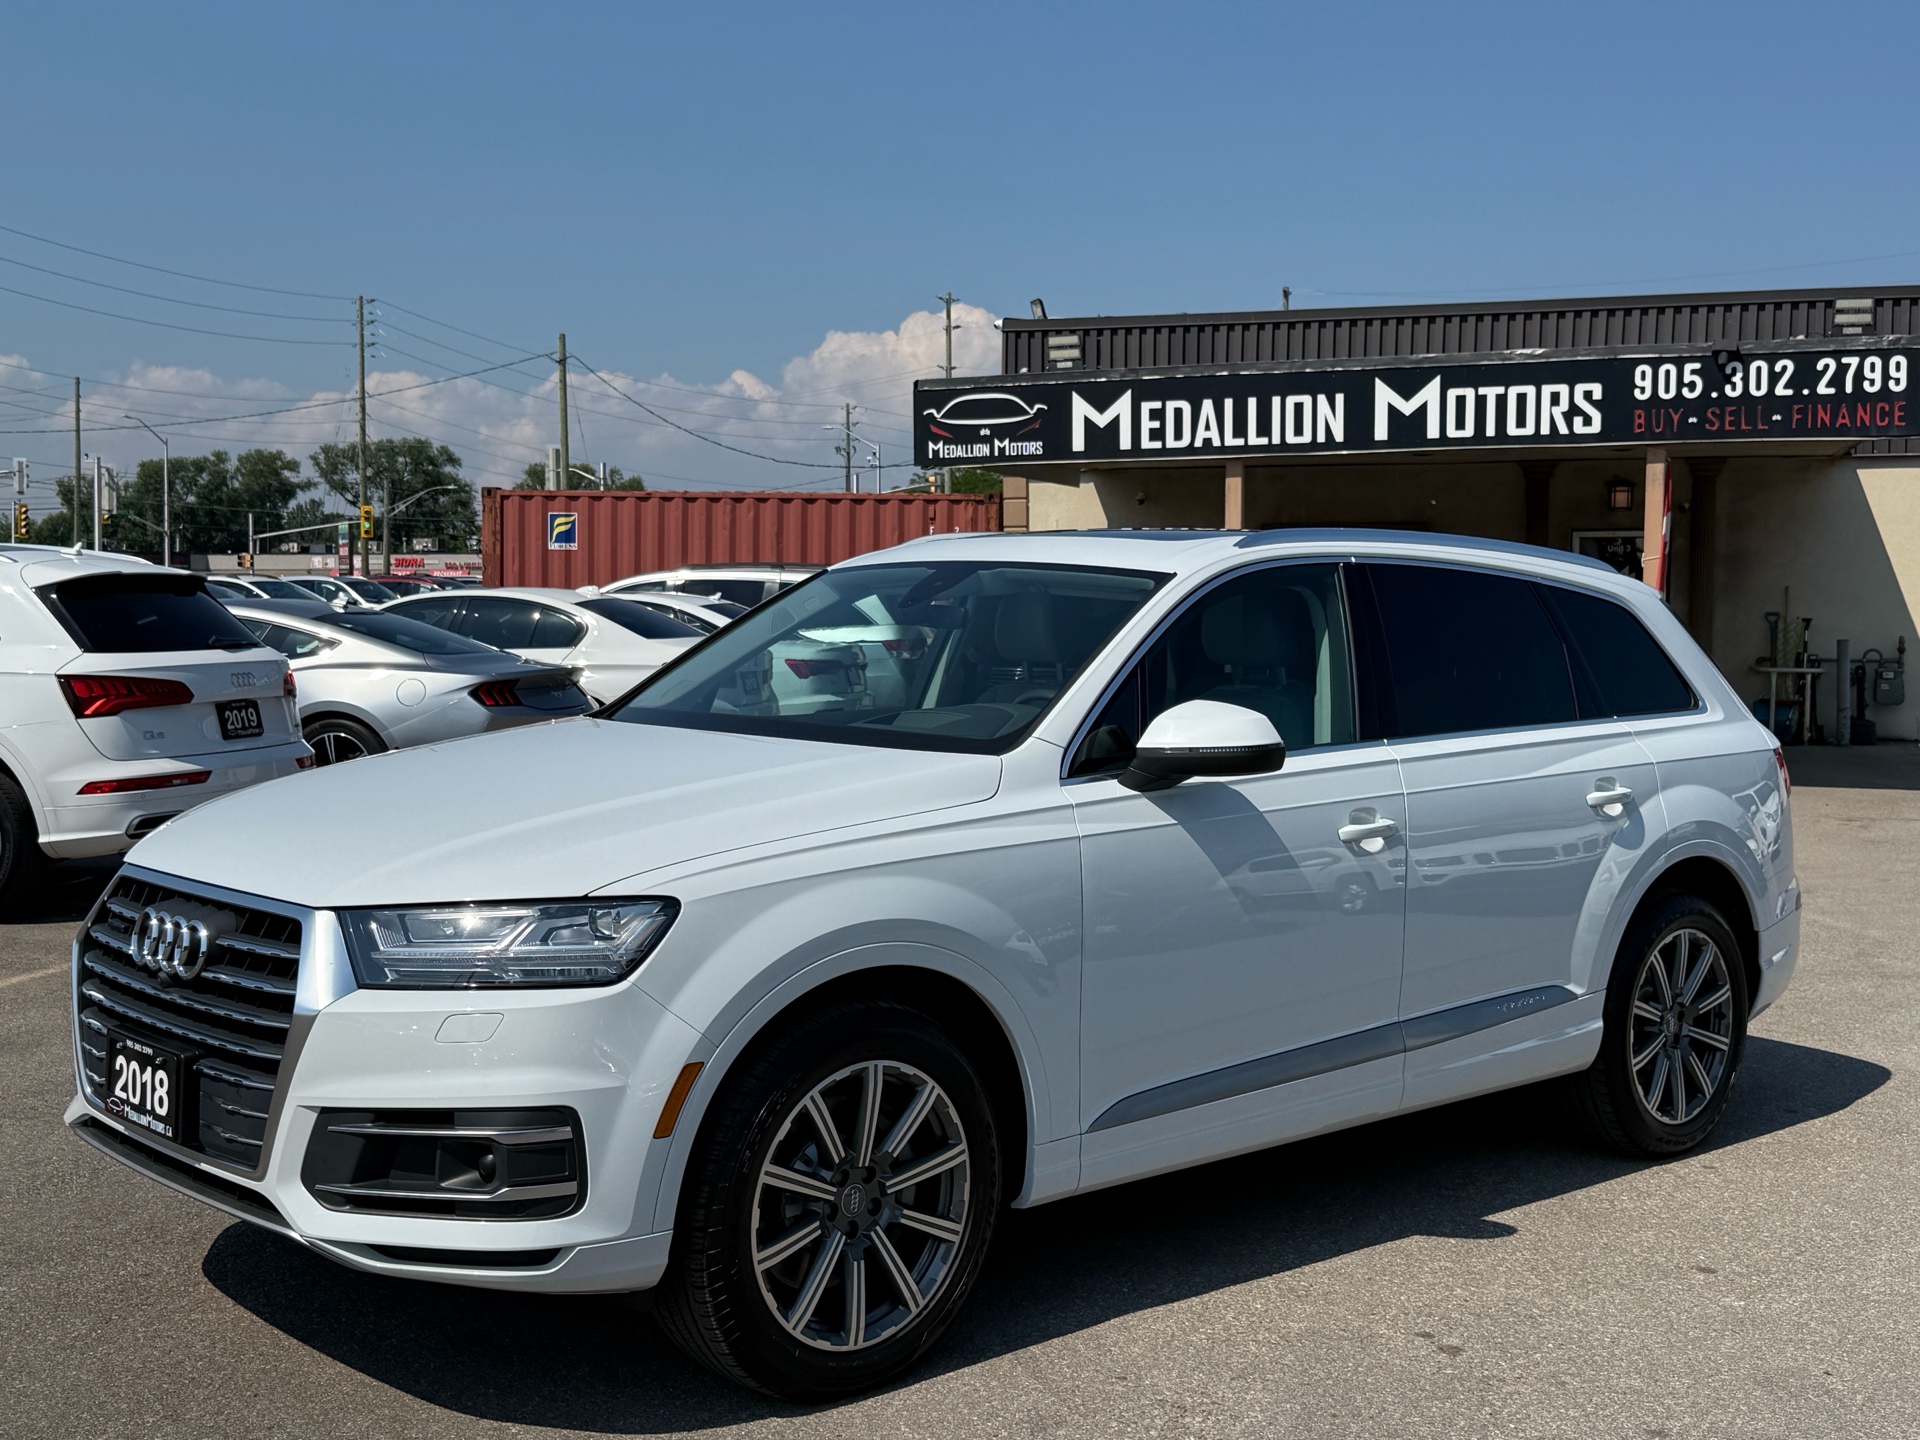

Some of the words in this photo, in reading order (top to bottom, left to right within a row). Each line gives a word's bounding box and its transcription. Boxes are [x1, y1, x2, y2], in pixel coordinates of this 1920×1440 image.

[1633, 354, 1908, 401] 905.302.2799
[1072, 388, 1345, 452] MEDALLION
[1374, 374, 1603, 441] MOTORS
[1633, 408, 1684, 433] BUY
[1704, 405, 1769, 431] SELL
[1791, 401, 1907, 429] FINANCE
[928, 440, 990, 459] MEDALLION
[994, 437, 1043, 457] MOTORS
[225, 708, 257, 730] 2019
[114, 1054, 169, 1117] 2018
